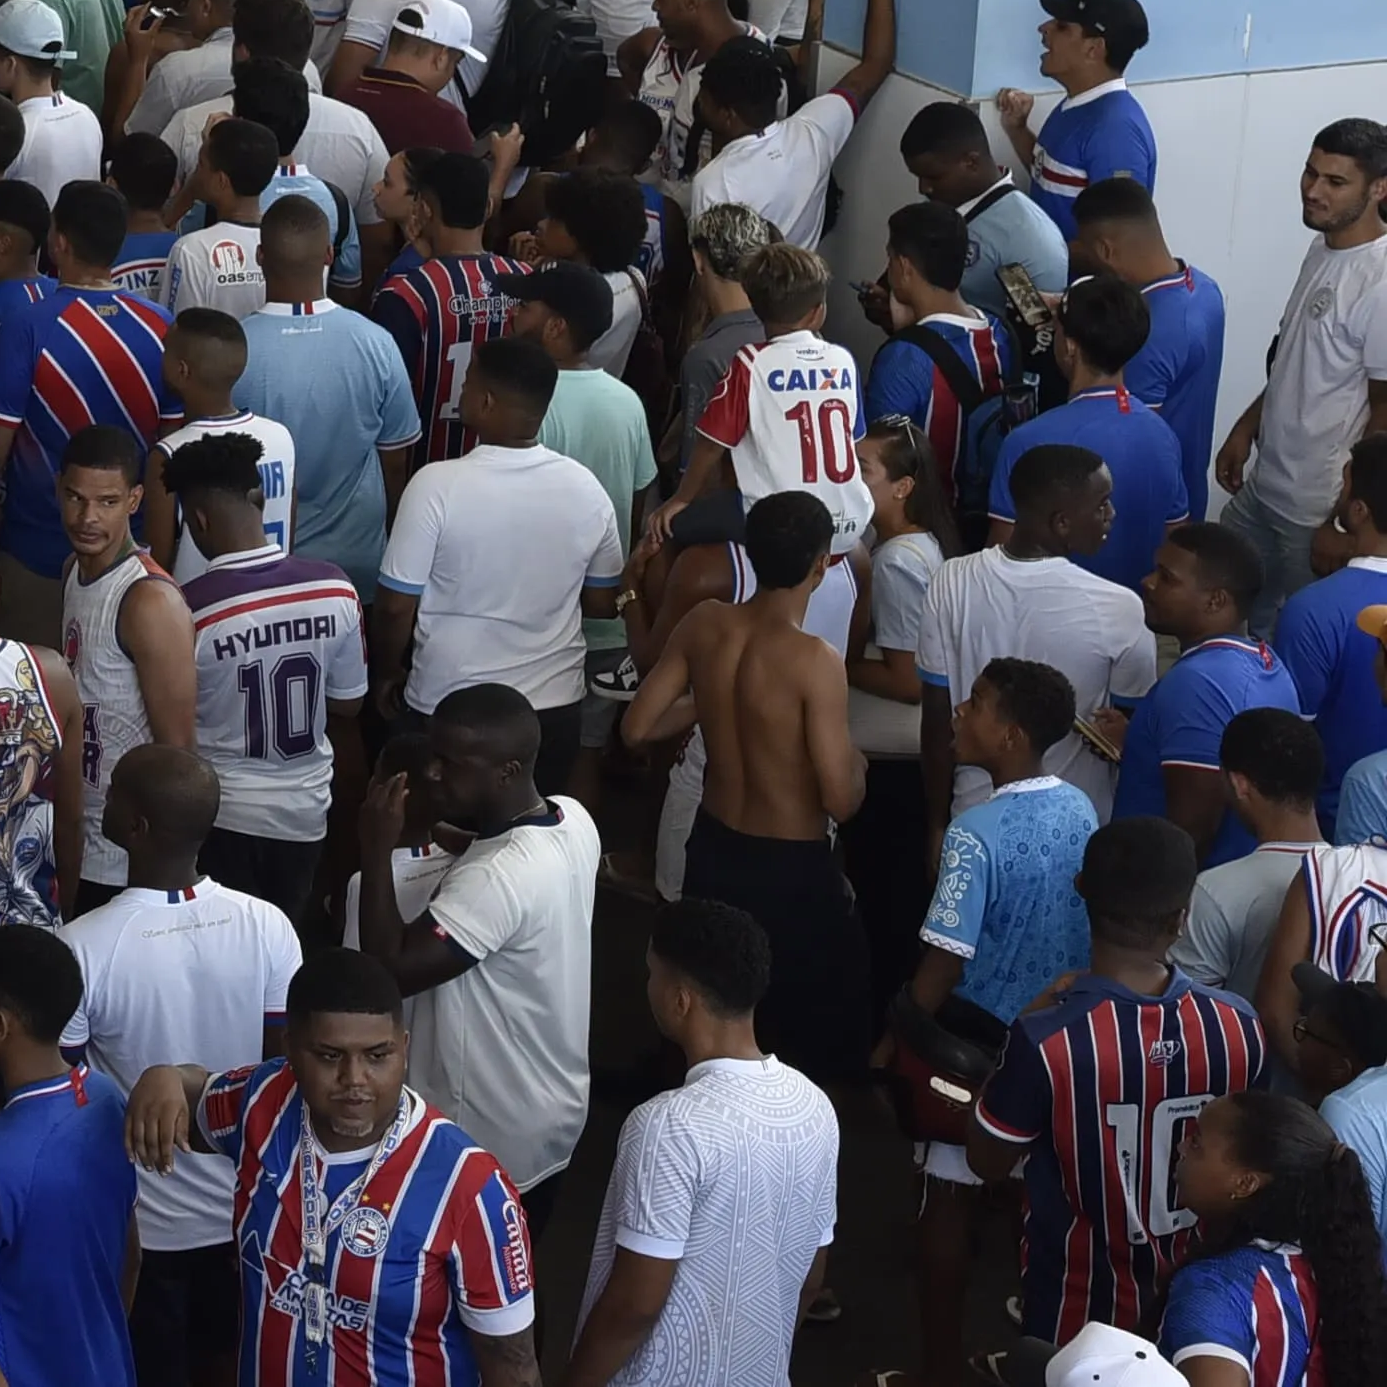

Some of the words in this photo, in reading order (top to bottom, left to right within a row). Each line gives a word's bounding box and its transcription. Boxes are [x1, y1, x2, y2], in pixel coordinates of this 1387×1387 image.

[217, 272, 245, 285] oas
[767, 368, 853, 392] CAIXA
[784, 398, 856, 484] 10
[212, 614, 337, 662] HYUNDAI
[236, 651, 324, 762] 10
[1105, 1092, 1217, 1246] 10
[340, 1297, 369, 1315] DE
